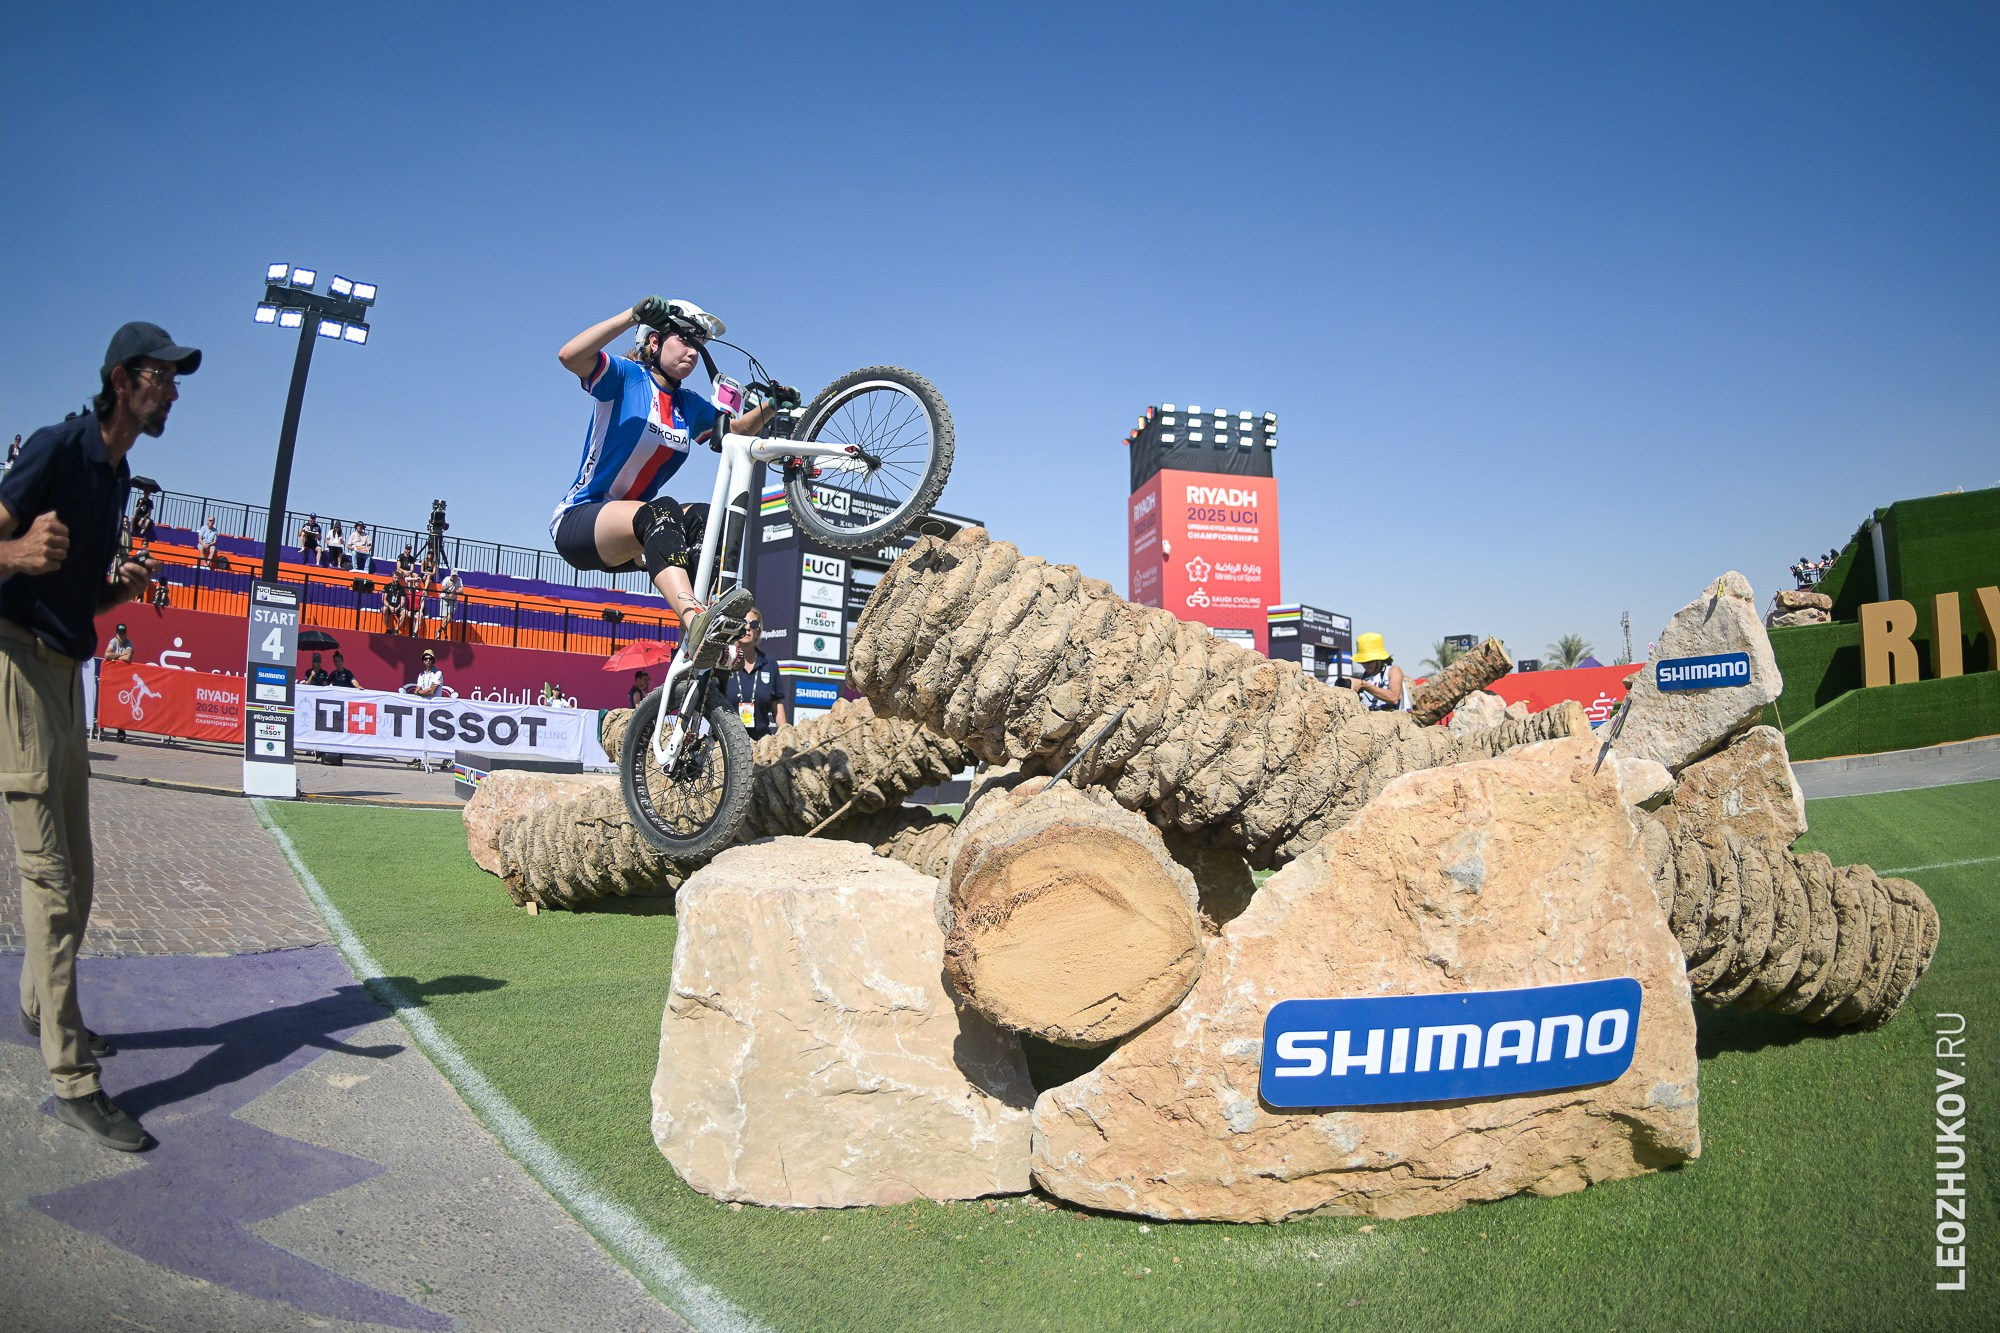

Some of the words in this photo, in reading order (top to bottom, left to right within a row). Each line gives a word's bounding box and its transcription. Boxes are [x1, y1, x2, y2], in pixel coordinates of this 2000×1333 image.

[730, 391, 737, 404] 7
[820, 491, 847, 510] UCI
[1186, 486, 1258, 508] RIYADH
[1187, 507, 1226, 522] 2025
[1231, 510, 1258, 524] UCI
[1187, 532, 1259, 543] CHAMPIONSHIPS
[812, 559, 839, 577] UCI
[1233, 596, 1261, 604] CYCLING
[254, 610, 296, 626] START
[805, 617, 836, 628] TISSOT
[262, 627, 284, 660] 4
[258, 672, 285, 680] SHIMANO
[809, 665, 826, 675] UCI
[1659, 660, 1748, 683] SHIMANO
[196, 688, 240, 705] RIYADH
[796, 688, 838, 699] SHIMANO
[196, 702, 219, 713] 2025
[222, 705, 239, 715] UCI
[384, 704, 547, 746] TISSOT
[465, 768, 476, 785] UCI
[1274, 1008, 1629, 1077] SHIMANO
